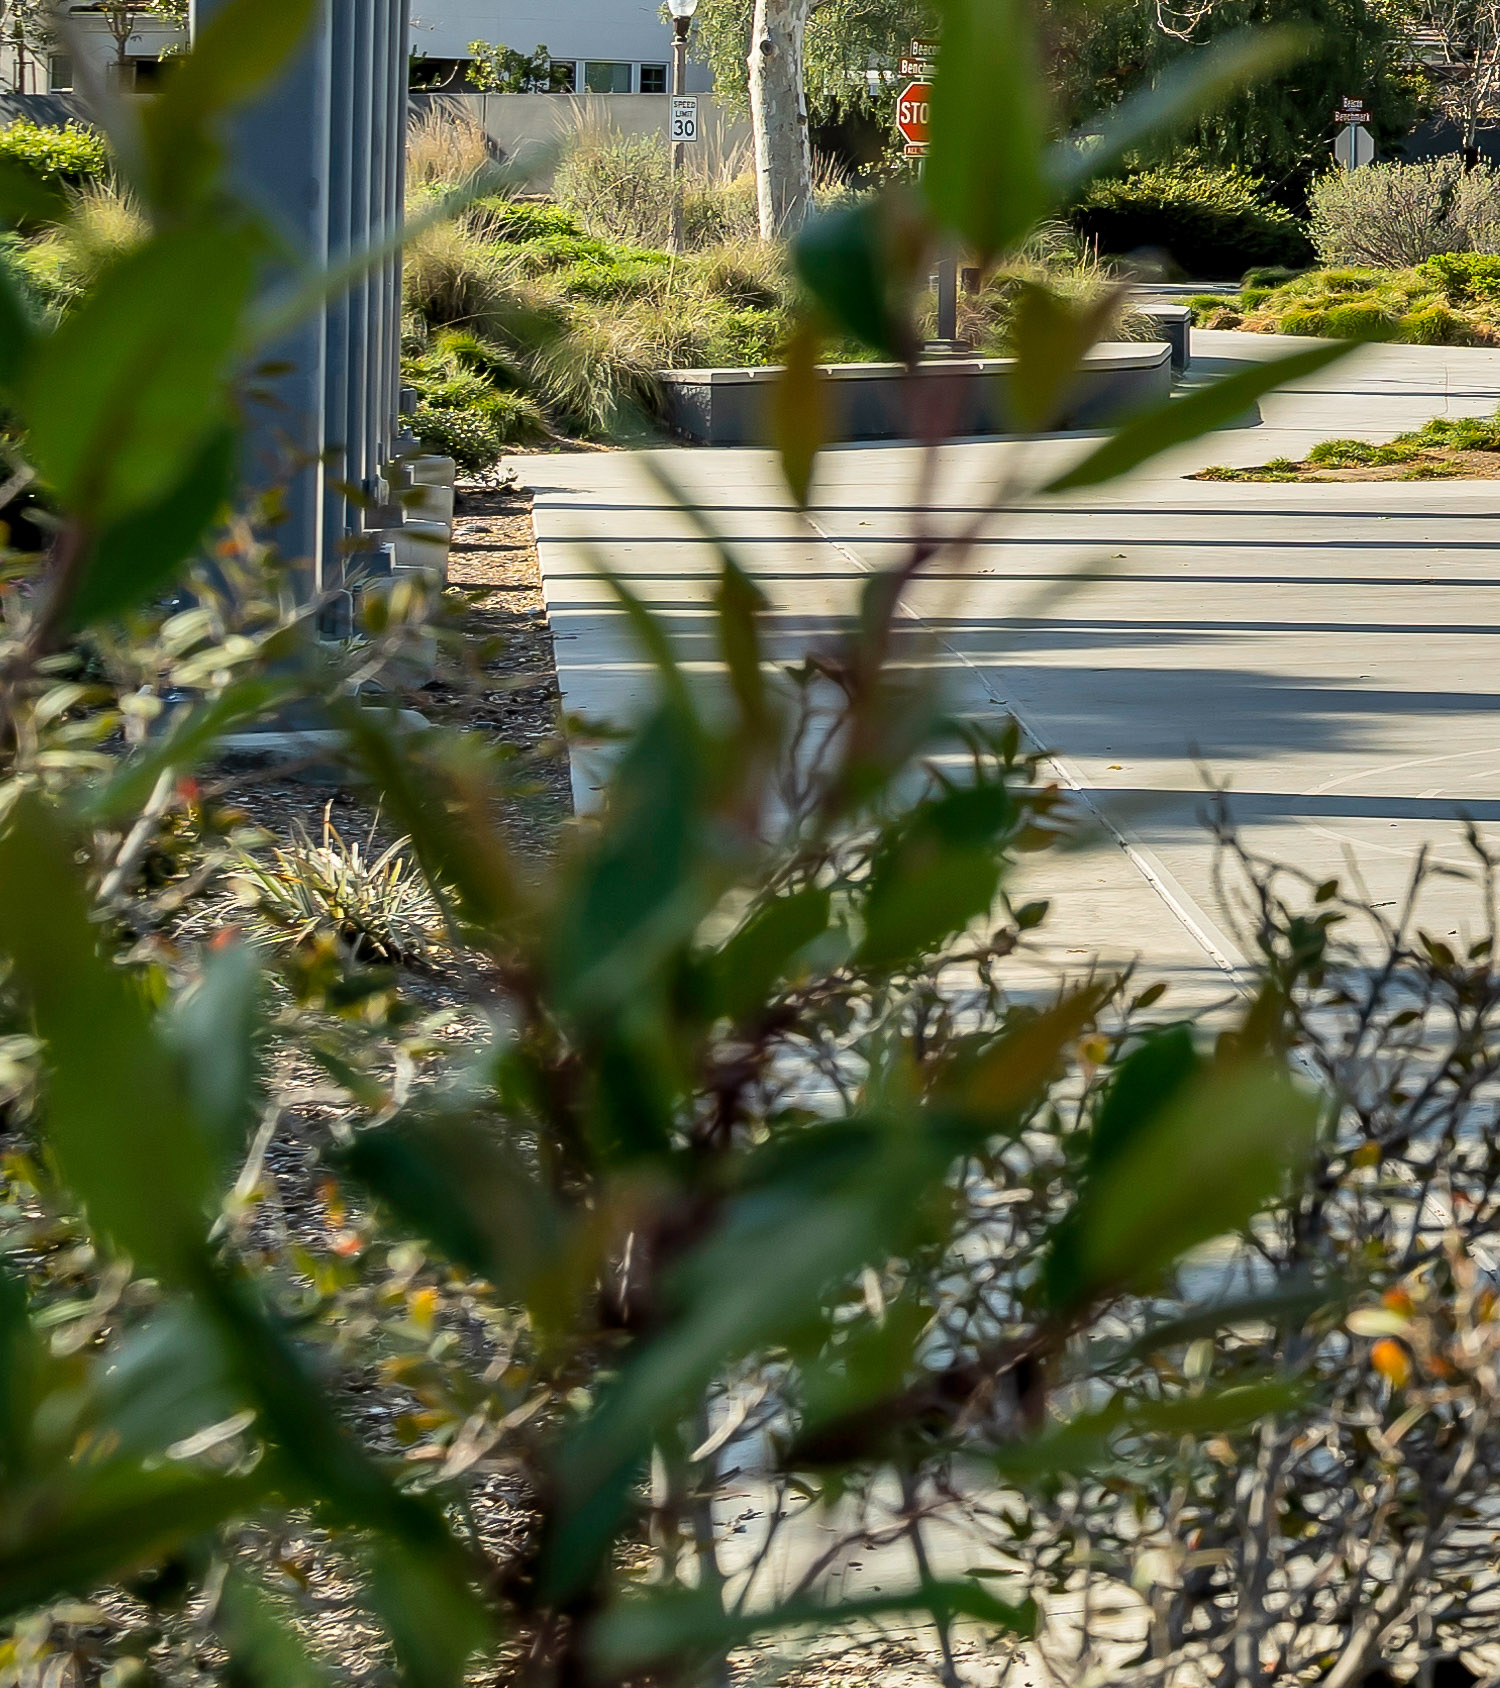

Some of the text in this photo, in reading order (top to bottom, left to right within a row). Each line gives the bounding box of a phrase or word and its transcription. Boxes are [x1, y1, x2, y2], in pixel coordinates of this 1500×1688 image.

[901, 59, 937, 74] Benchm
[673, 100, 696, 109] SPEED
[675, 110, 694, 118] LIMIT
[900, 101, 930, 124] STO
[673, 119, 695, 137] 30
